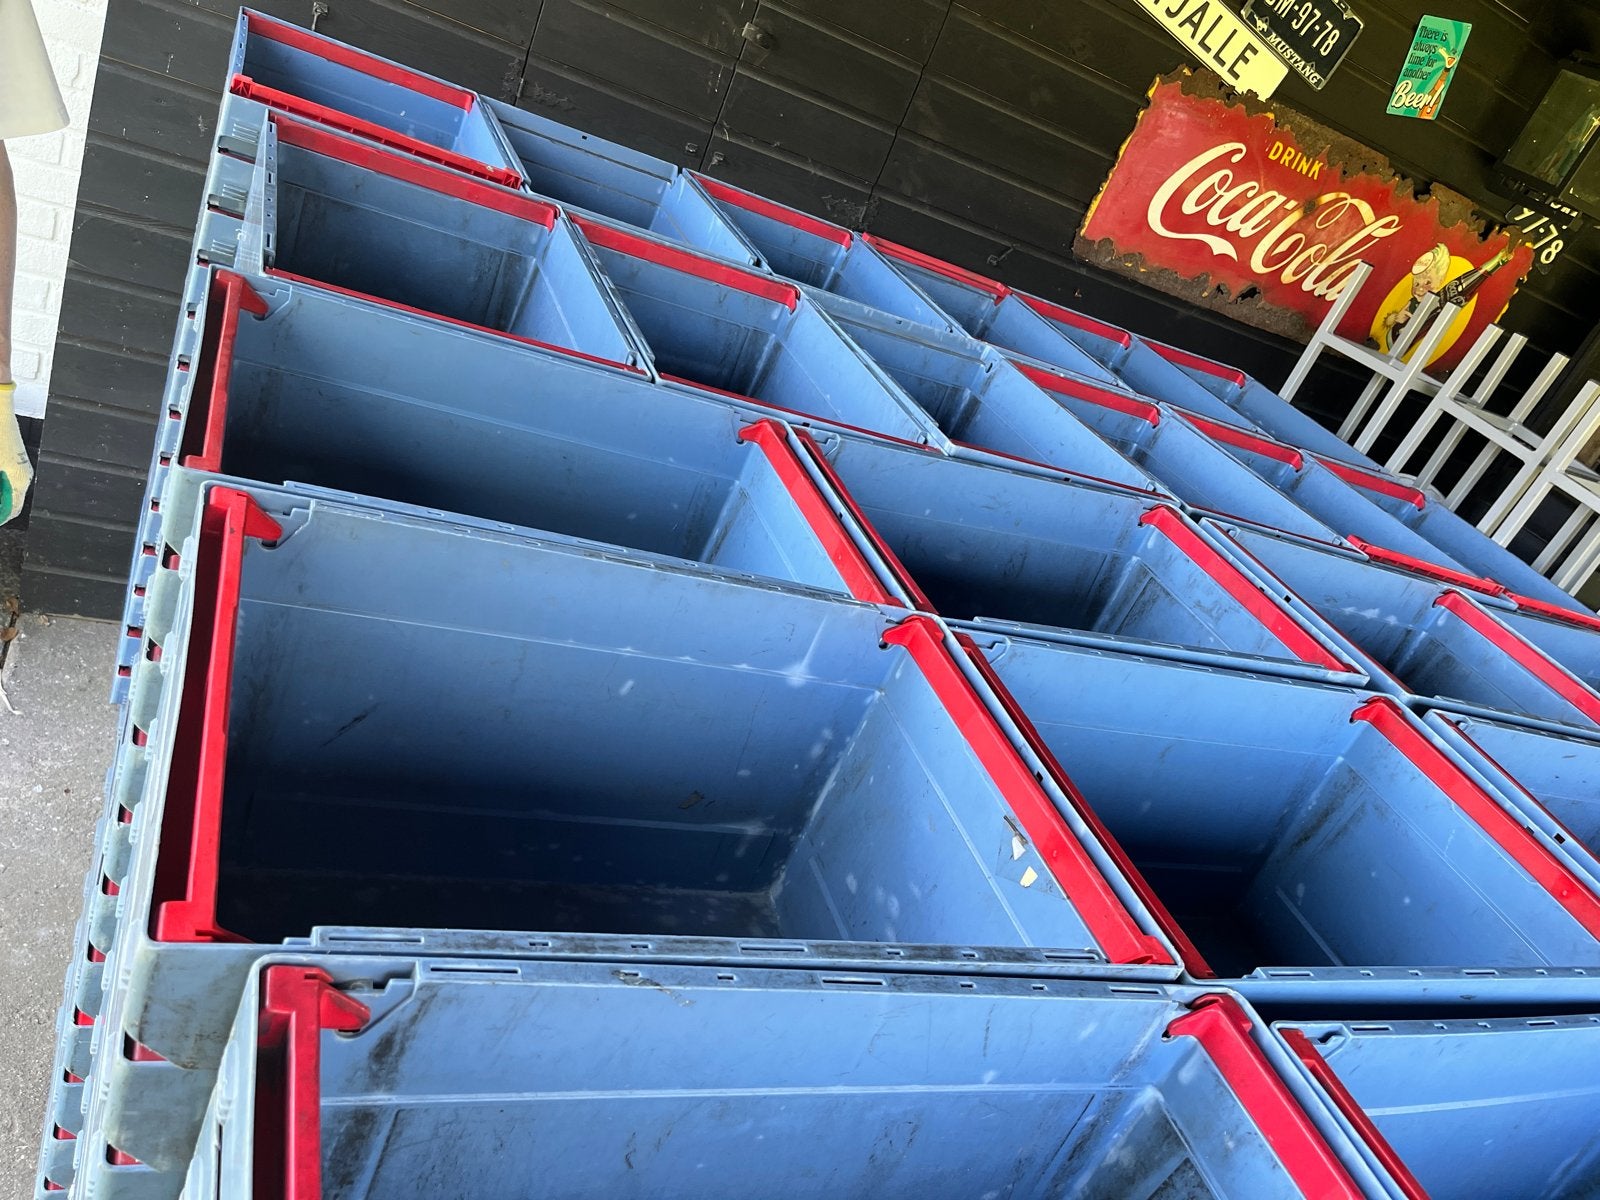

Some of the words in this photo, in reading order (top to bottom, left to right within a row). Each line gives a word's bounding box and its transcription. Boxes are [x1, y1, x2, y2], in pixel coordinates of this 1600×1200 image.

[1419, 26, 1439, 41] There
[1413, 41, 1438, 54] always
[1267, 31, 1318, 84] MUSTANG
[1407, 53, 1425, 66] time
[1426, 56, 1437, 68] for
[1402, 67, 1431, 80] another
[1391, 80, 1445, 114] Beer!
[1268, 141, 1324, 180] DRINK
